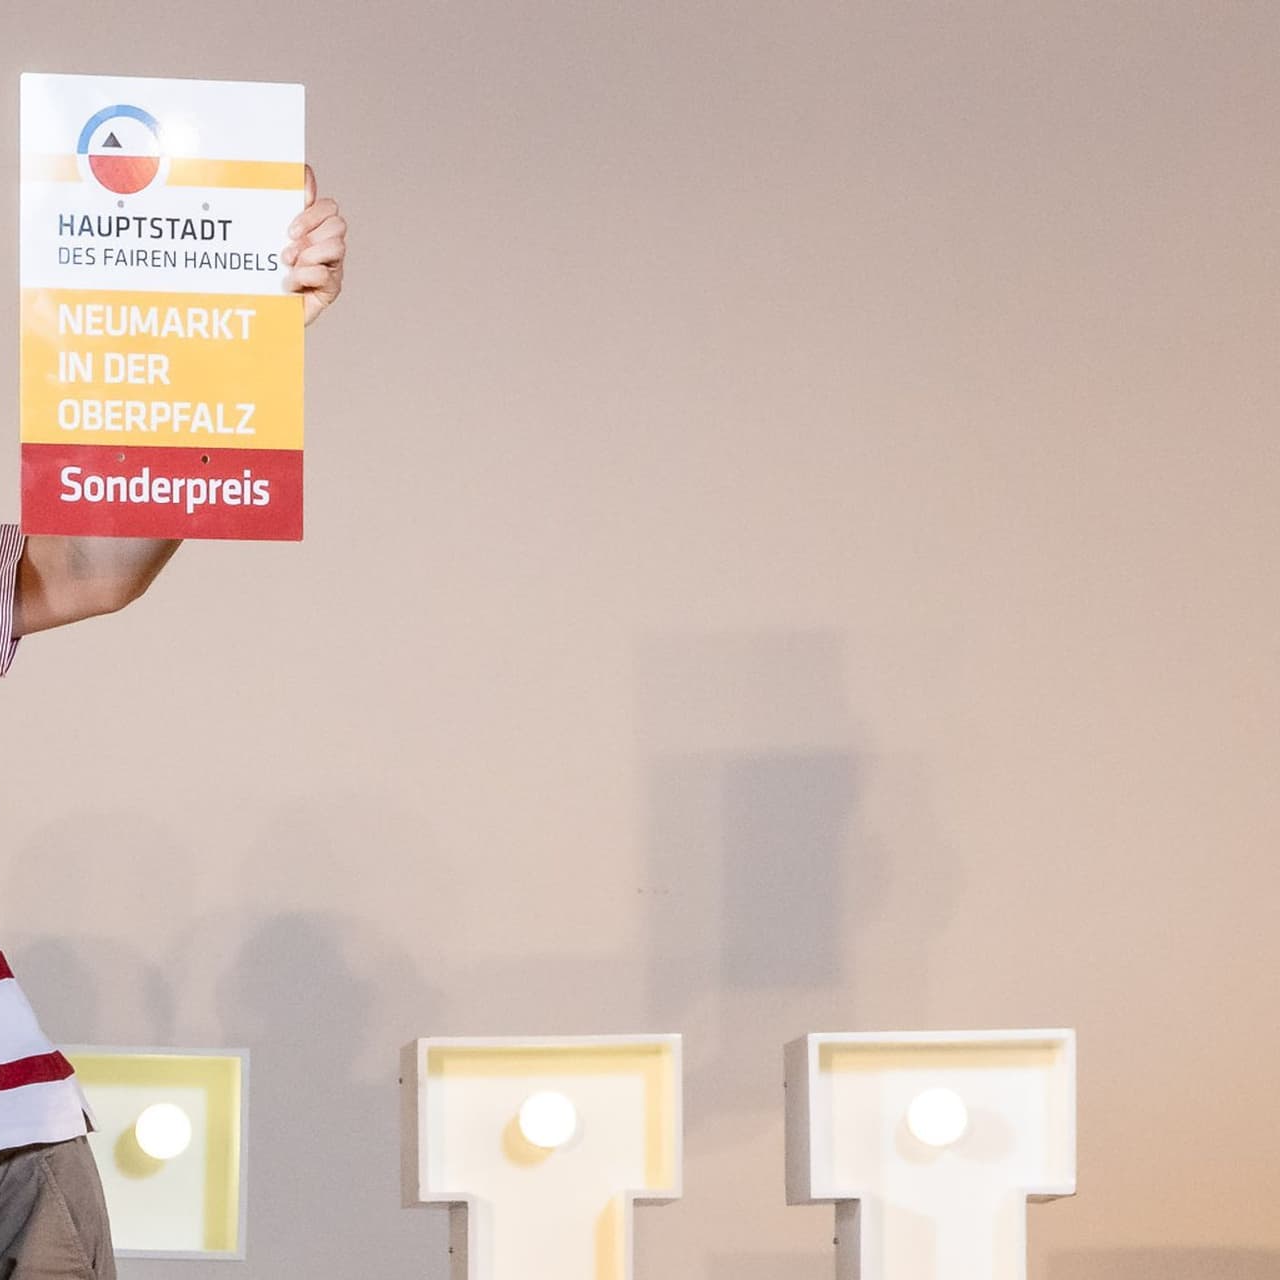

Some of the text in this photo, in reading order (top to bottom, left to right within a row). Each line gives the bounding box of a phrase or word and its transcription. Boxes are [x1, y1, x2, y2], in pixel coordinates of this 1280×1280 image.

[58, 213, 233, 241] HAUPTSTADT
[58, 246, 279, 272] DES FAIREN HANDELS
[58, 304, 256, 340] NEUMARKT
[58, 351, 171, 385] IN DER
[57, 399, 256, 435] OBERPFALZ
[60, 466, 271, 513] Sonderpreis
